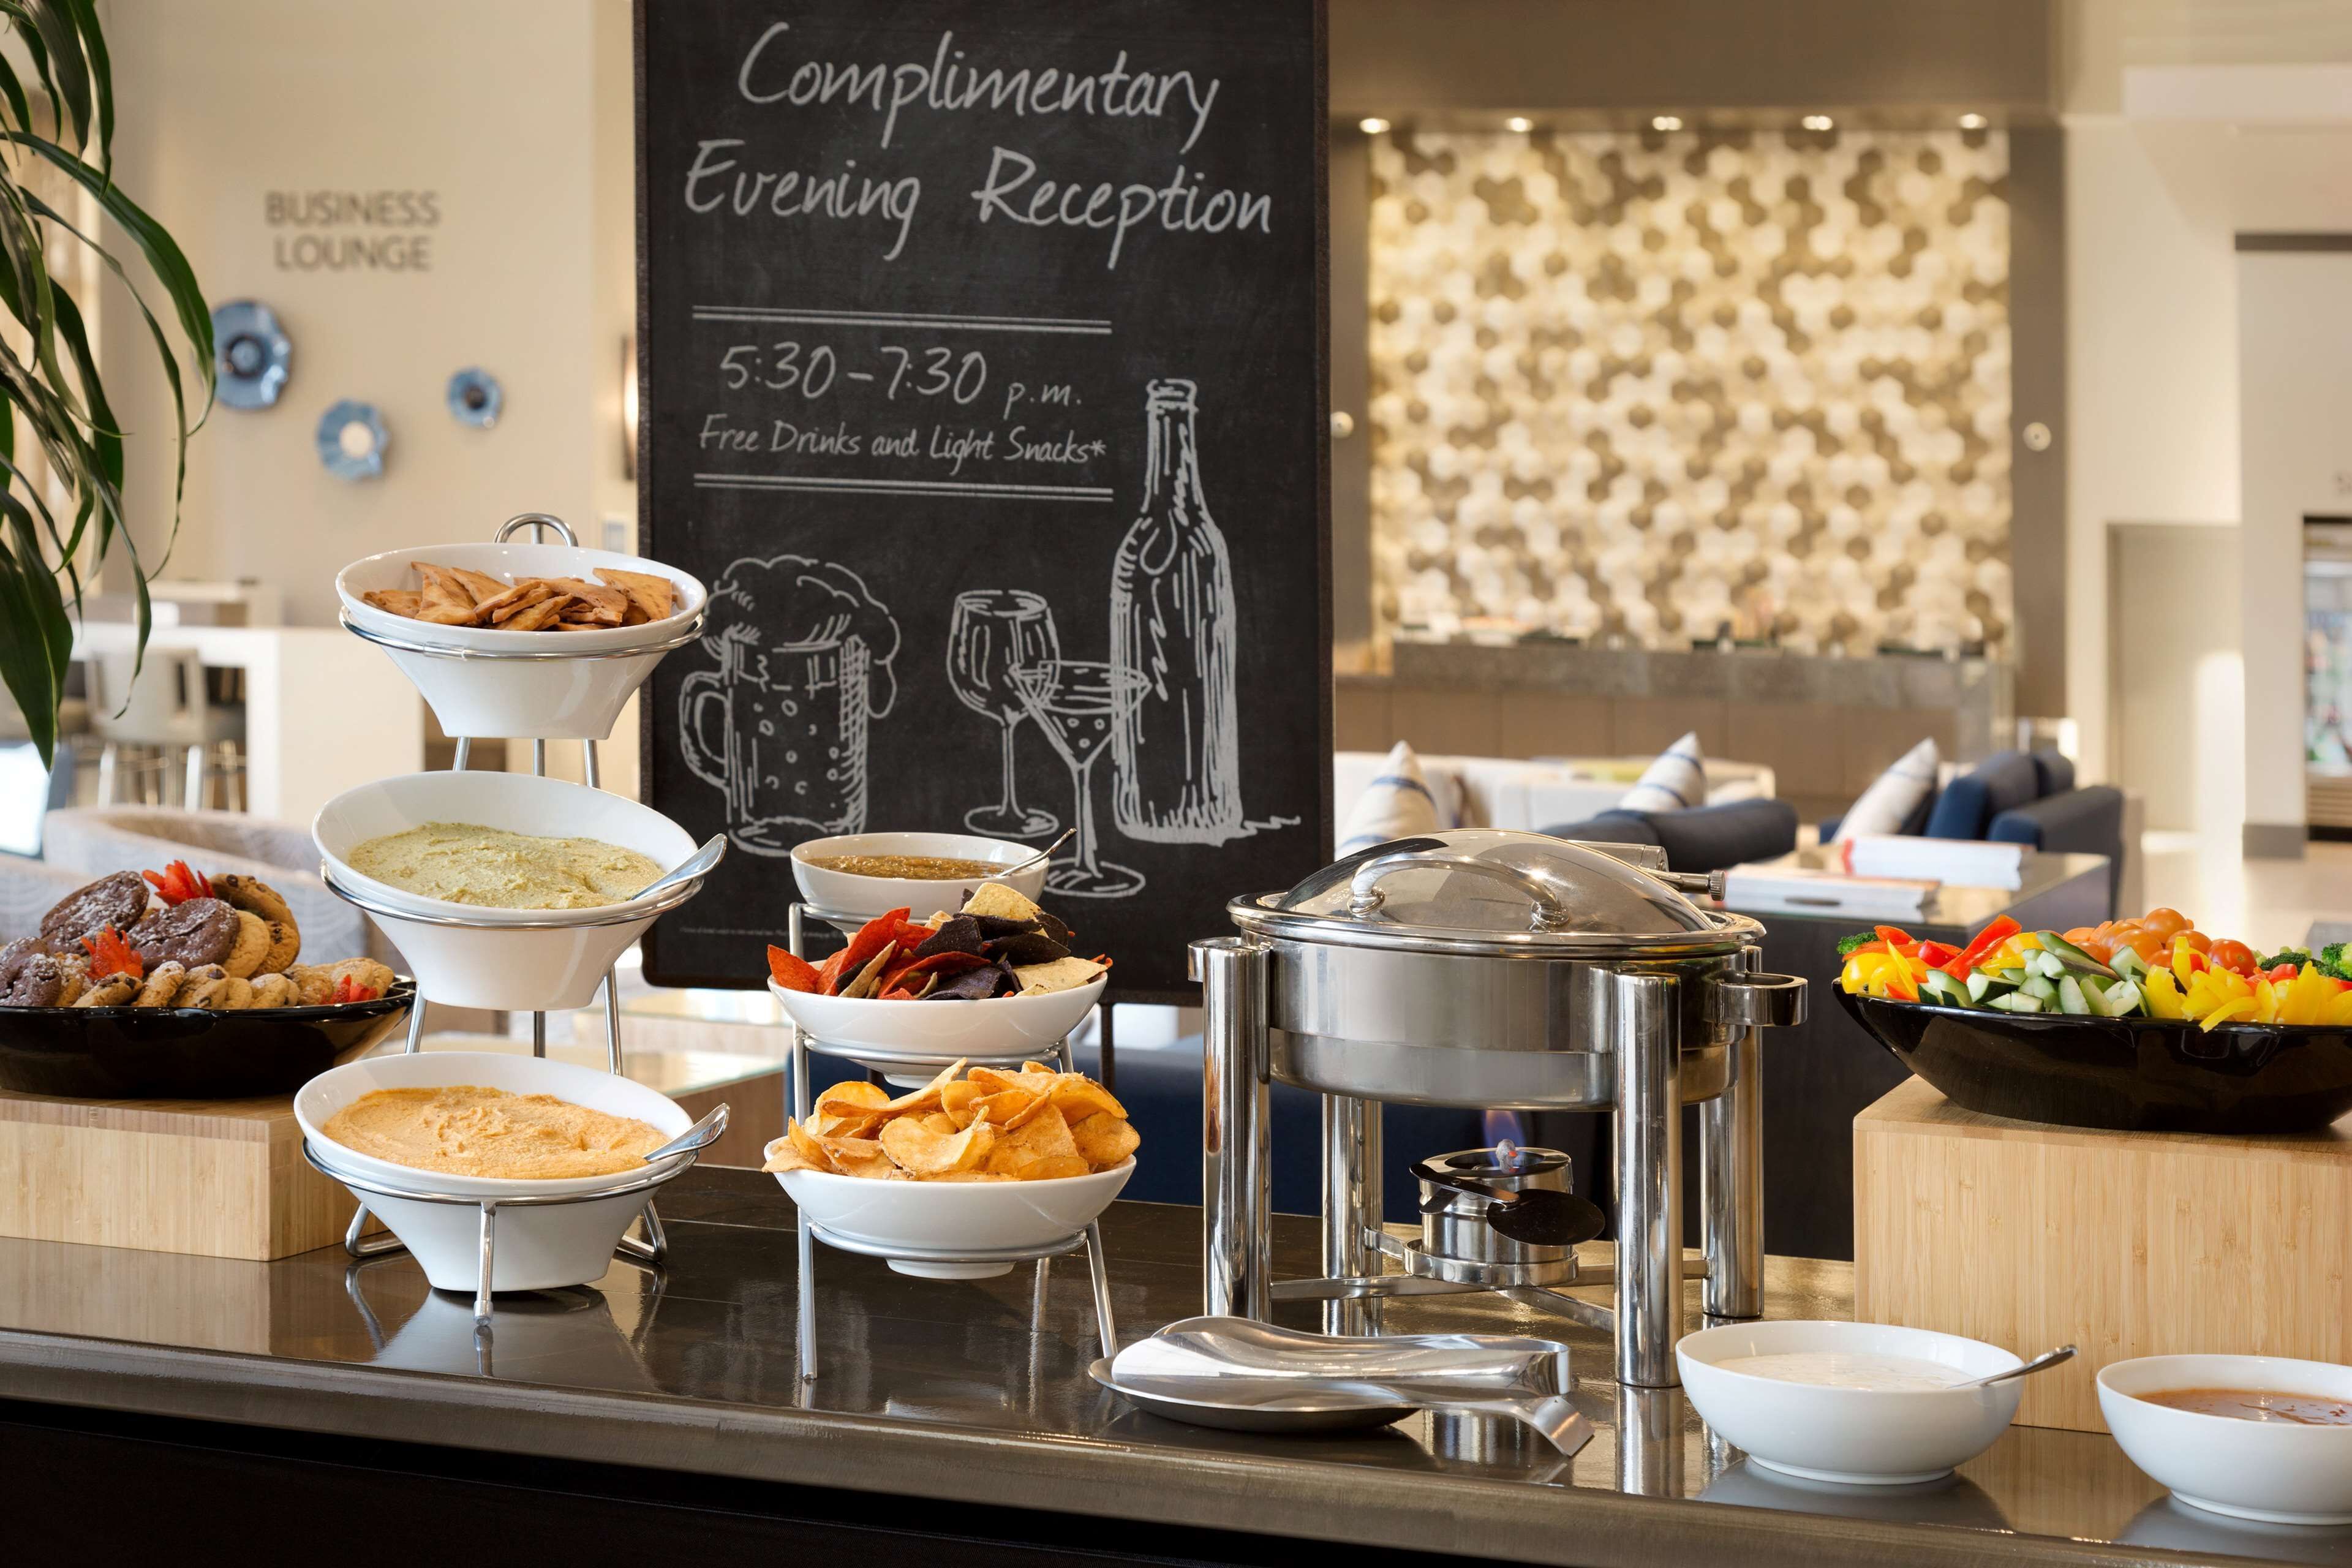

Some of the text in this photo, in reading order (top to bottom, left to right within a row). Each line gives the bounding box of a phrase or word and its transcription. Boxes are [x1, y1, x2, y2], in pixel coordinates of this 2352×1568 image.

[738, 21, 1219, 154] Complimentary
[264, 190, 441, 227] BUSINESS
[684, 138, 1272, 270] Evening Reception
[273, 234, 434, 272] LOUNGE
[1003, 382, 1083, 421] p.m.
[698, 413, 761, 450] Free
[769, 419, 862, 455] Drinks
[870, 428, 920, 458] and
[929, 424, 996, 477] Light
